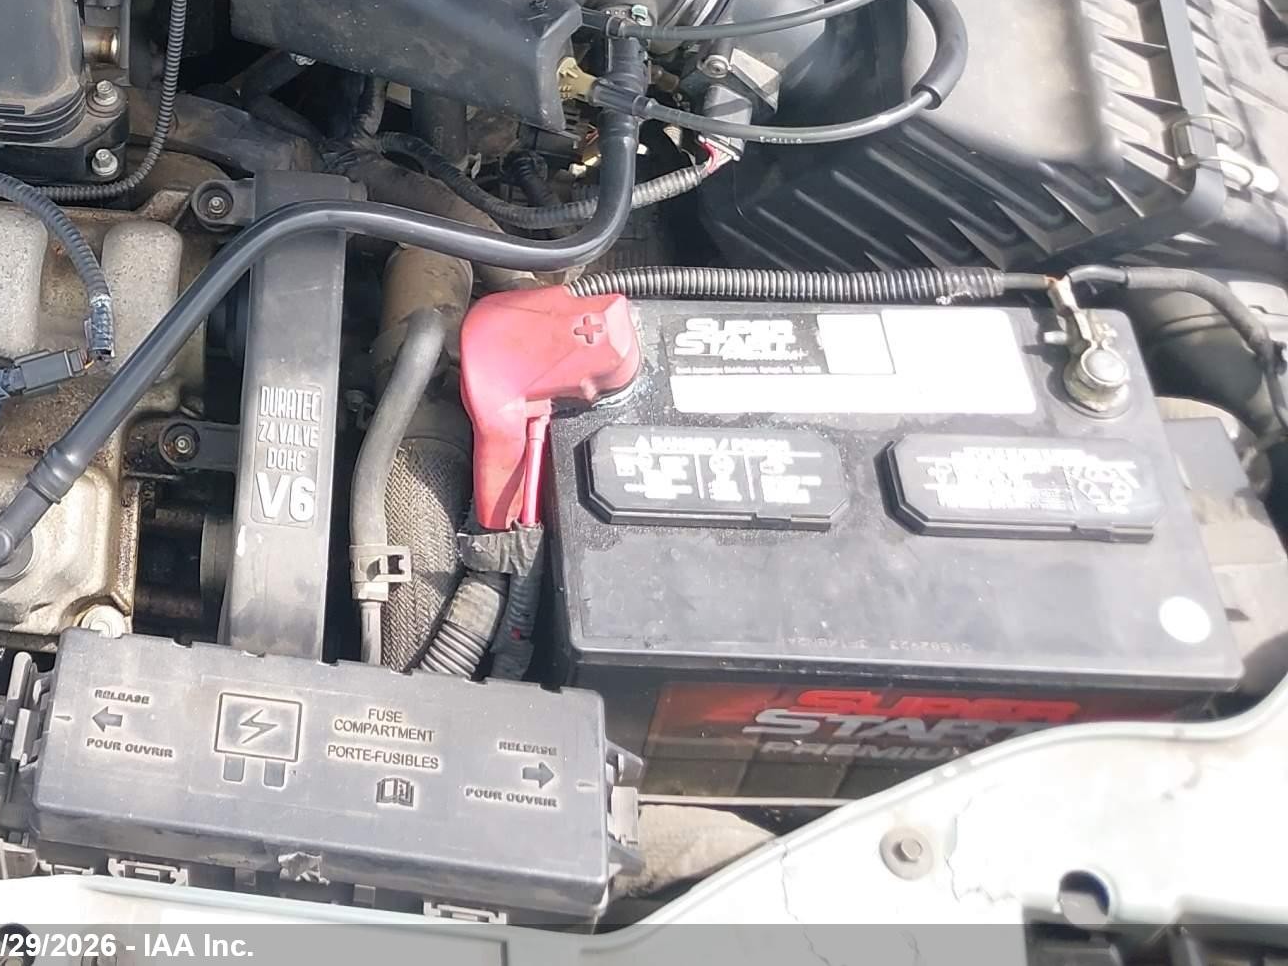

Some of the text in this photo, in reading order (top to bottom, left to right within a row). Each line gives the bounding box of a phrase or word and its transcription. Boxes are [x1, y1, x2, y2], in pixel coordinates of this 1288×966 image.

[260, 386, 321, 422] DURATEC
[278, 423, 319, 448] VALVE
[266, 447, 308, 472] DOHC
[256, 472, 316, 522] V6
[94, 689, 150, 704] RELEASE
[797, 690, 1081, 723] SUPER
[368, 708, 403, 723] FUSE
[334, 718, 435, 742] COMPARTMENT
[86, 737, 173, 758] POUR OUVRIR
[327, 744, 440, 770] PORTE-FUSIBLES
[499, 741, 557, 755] RELEASE
[762, 740, 953, 761] PREMIU
[465, 788, 557, 808] POUR OUVRIR
